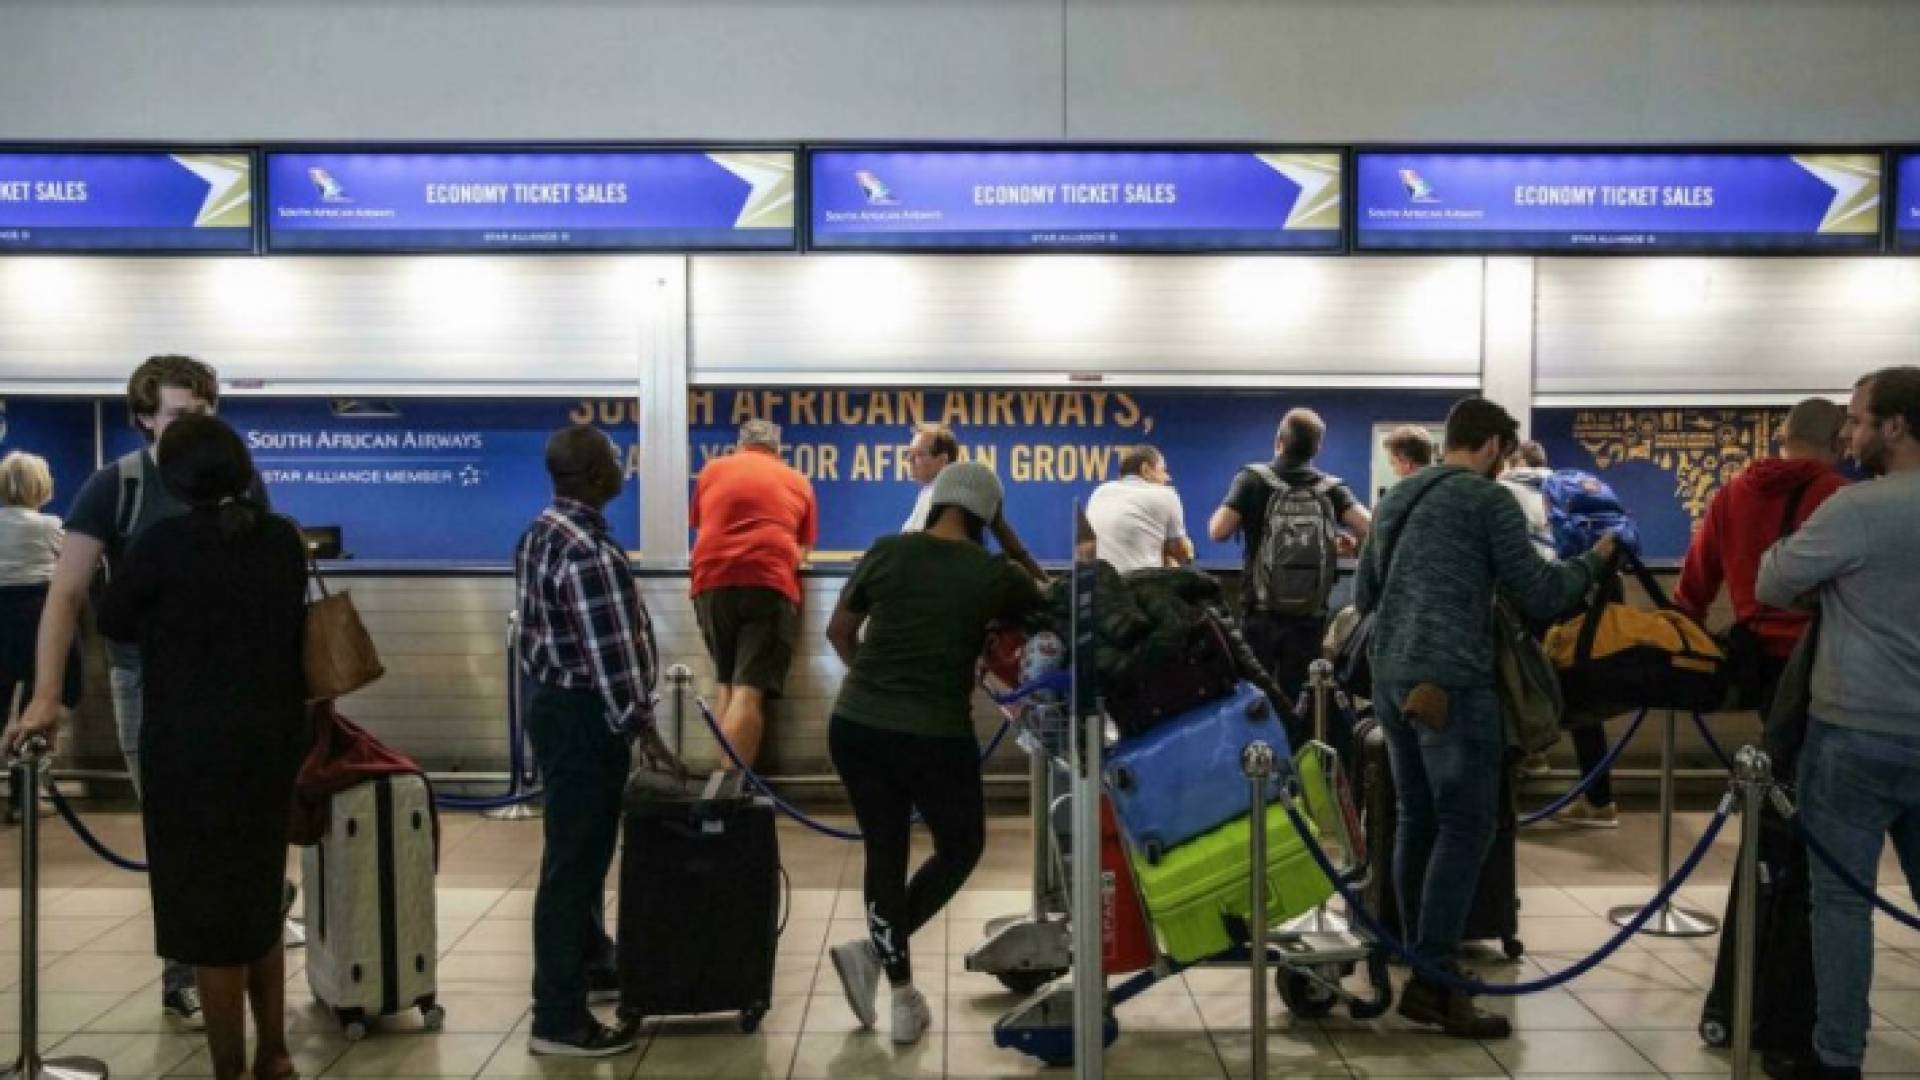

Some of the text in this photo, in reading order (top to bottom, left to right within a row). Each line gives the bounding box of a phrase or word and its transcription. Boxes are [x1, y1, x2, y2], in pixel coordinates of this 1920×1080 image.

[34, 182, 88, 202] SALES
[426, 183, 628, 204] ECONOMY TICKET SALES
[973, 184, 1177, 205] ECONOMY TICKET SALES
[1514, 185, 1714, 206] ECONOMY TICKET SALES
[731, 390, 924, 425] AFRICAN
[247, 431, 482, 449] SOUTH AFRICAN AIRWAYS
[261, 469, 452, 484] STAR ALLIANCE MEMBER
